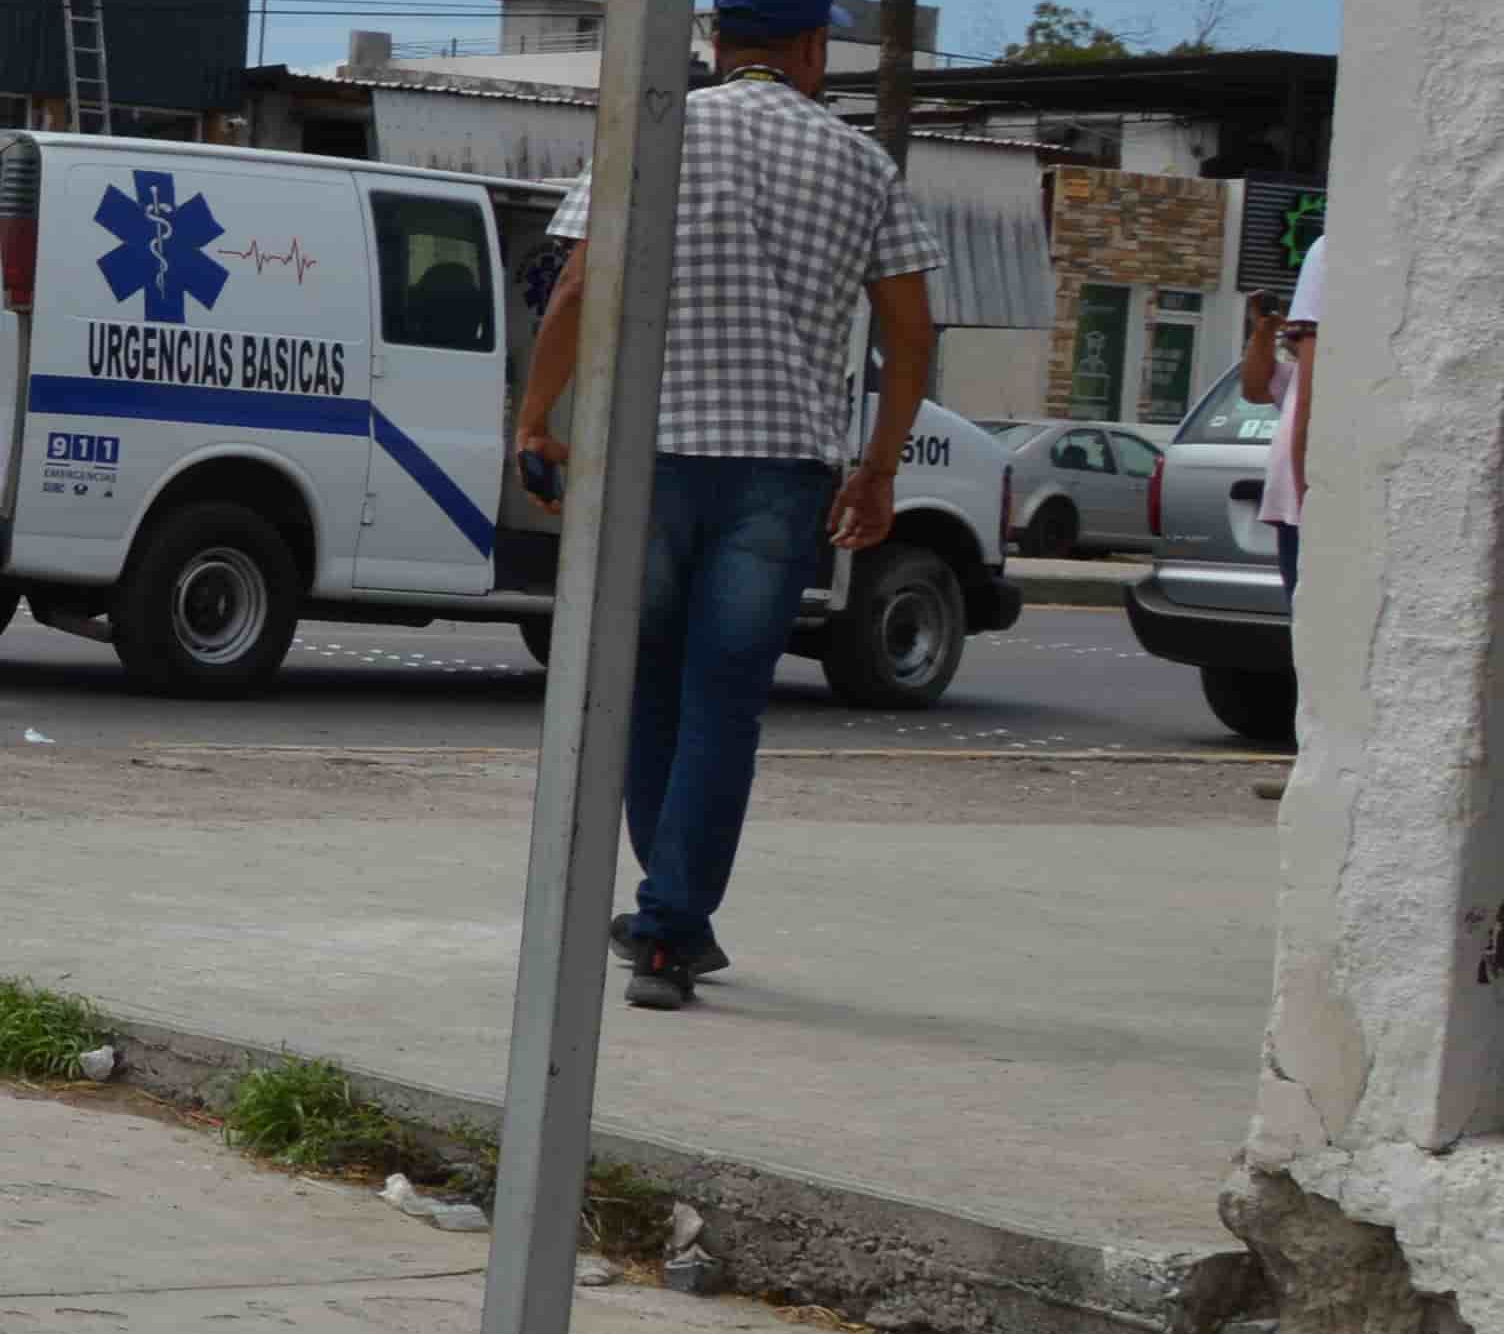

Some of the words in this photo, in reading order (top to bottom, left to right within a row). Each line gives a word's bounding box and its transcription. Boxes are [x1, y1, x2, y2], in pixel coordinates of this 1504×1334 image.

[88, 321, 233, 387] URGENCIAS
[241, 335, 345, 395] BASICAS
[52, 435, 117, 462] 911
